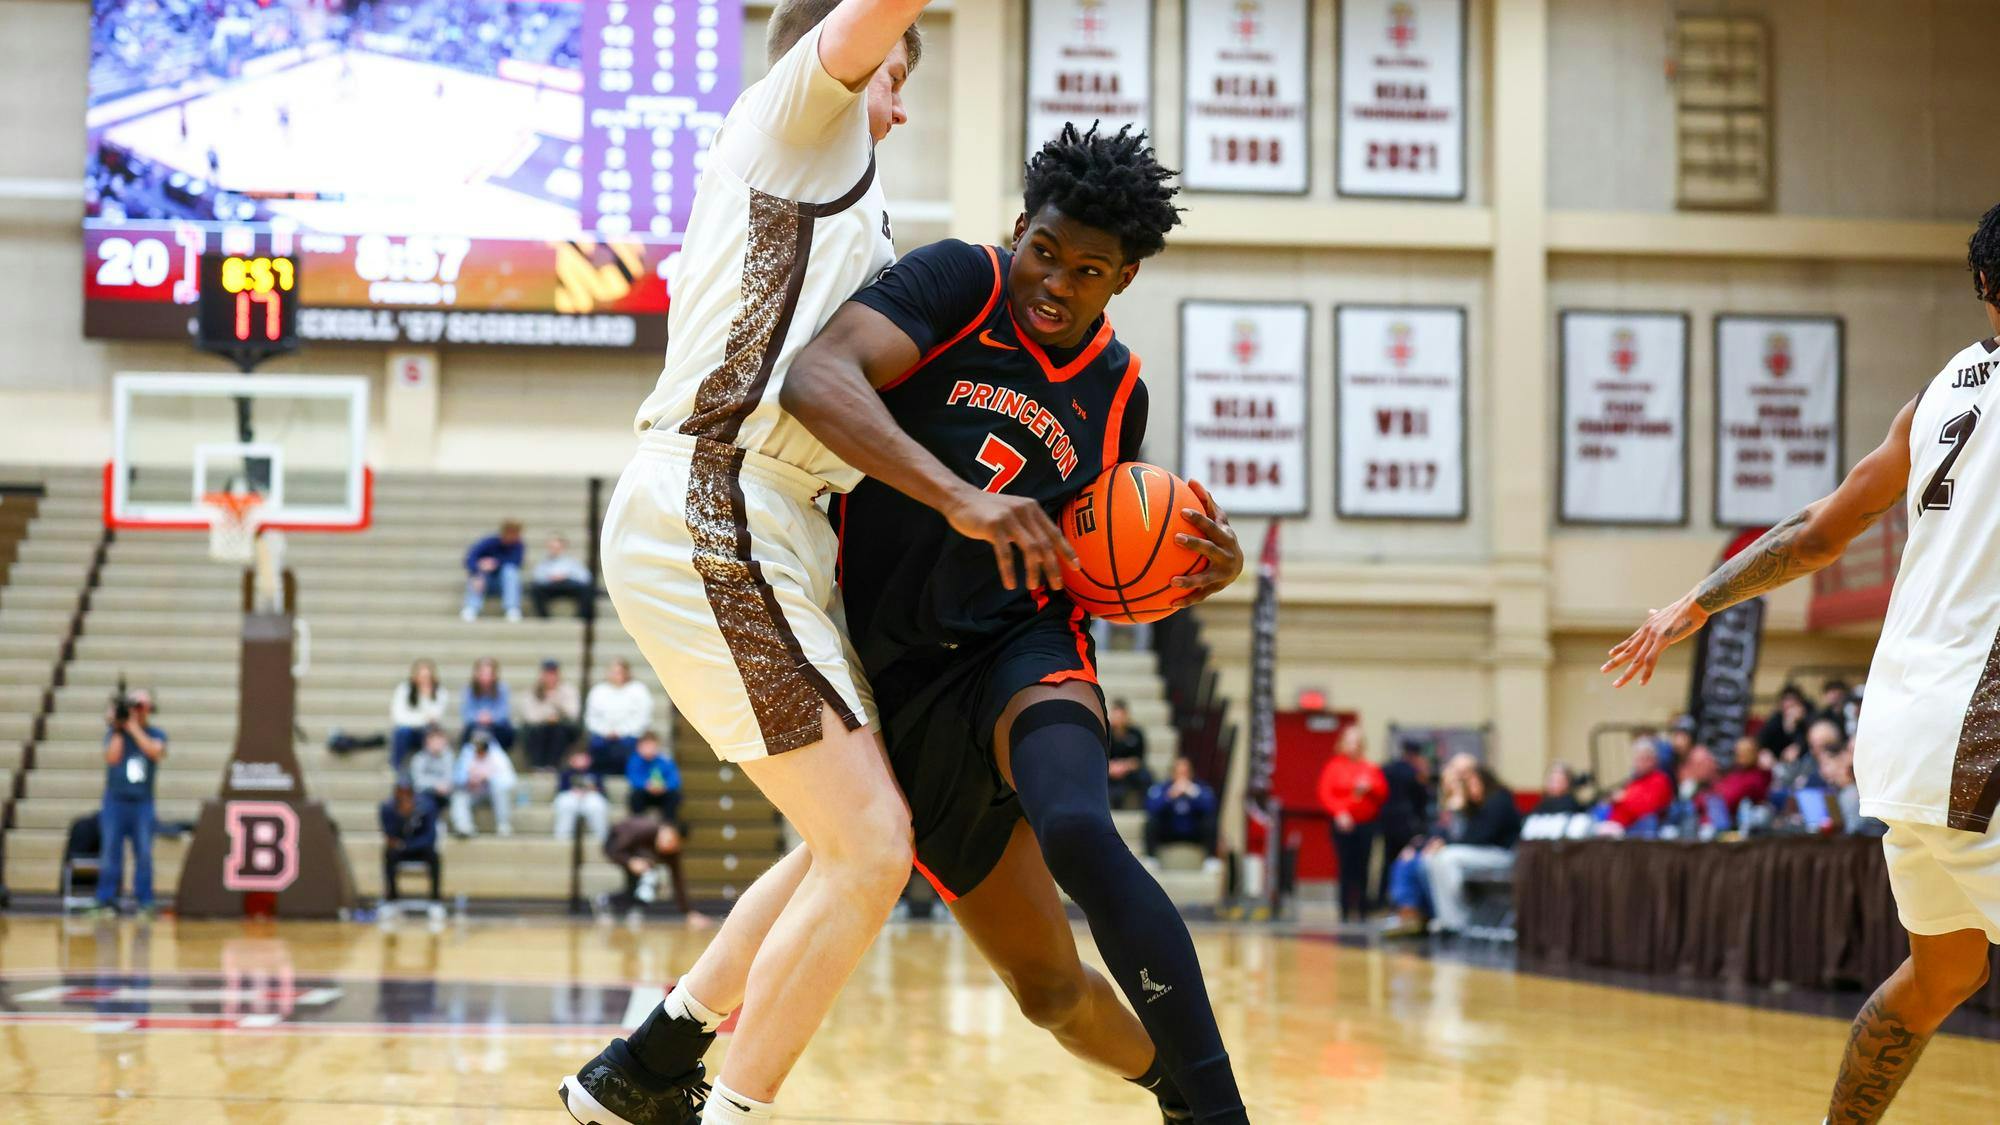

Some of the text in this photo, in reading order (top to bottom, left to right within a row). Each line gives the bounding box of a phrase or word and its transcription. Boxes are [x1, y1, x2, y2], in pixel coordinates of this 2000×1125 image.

[96, 237, 170, 287] 20
[222, 257, 294, 293] 8:57
[235, 289, 281, 341] 17
[446, 312, 636, 347] SCOREBOARD
[946, 380, 1079, 482] PRINCETON
[975, 432, 1027, 494] 7
[1917, 404, 1981, 517] 2
[228, 806, 294, 886] B
